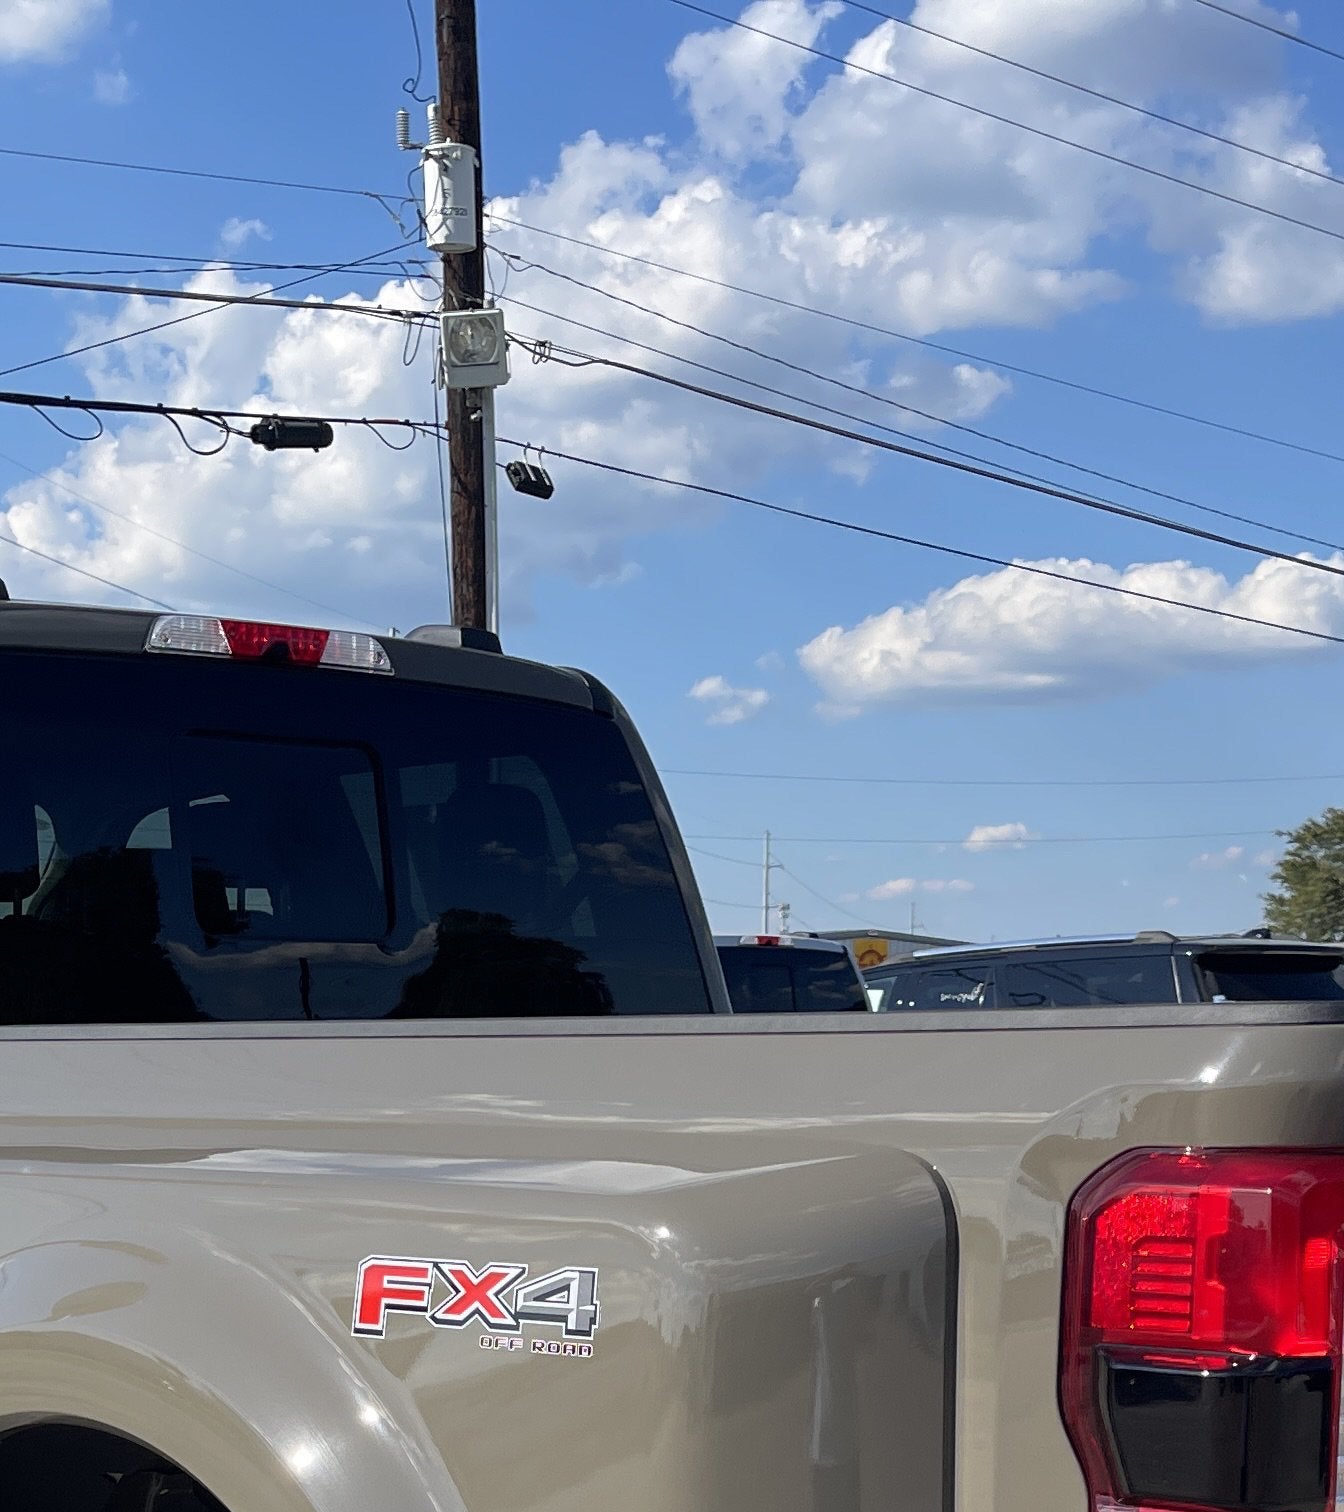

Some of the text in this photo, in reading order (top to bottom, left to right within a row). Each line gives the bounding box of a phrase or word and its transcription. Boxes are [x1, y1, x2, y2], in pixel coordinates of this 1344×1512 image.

[351, 1254, 601, 1340] FX4
[479, 1335, 594, 1358] OFF ROAD
